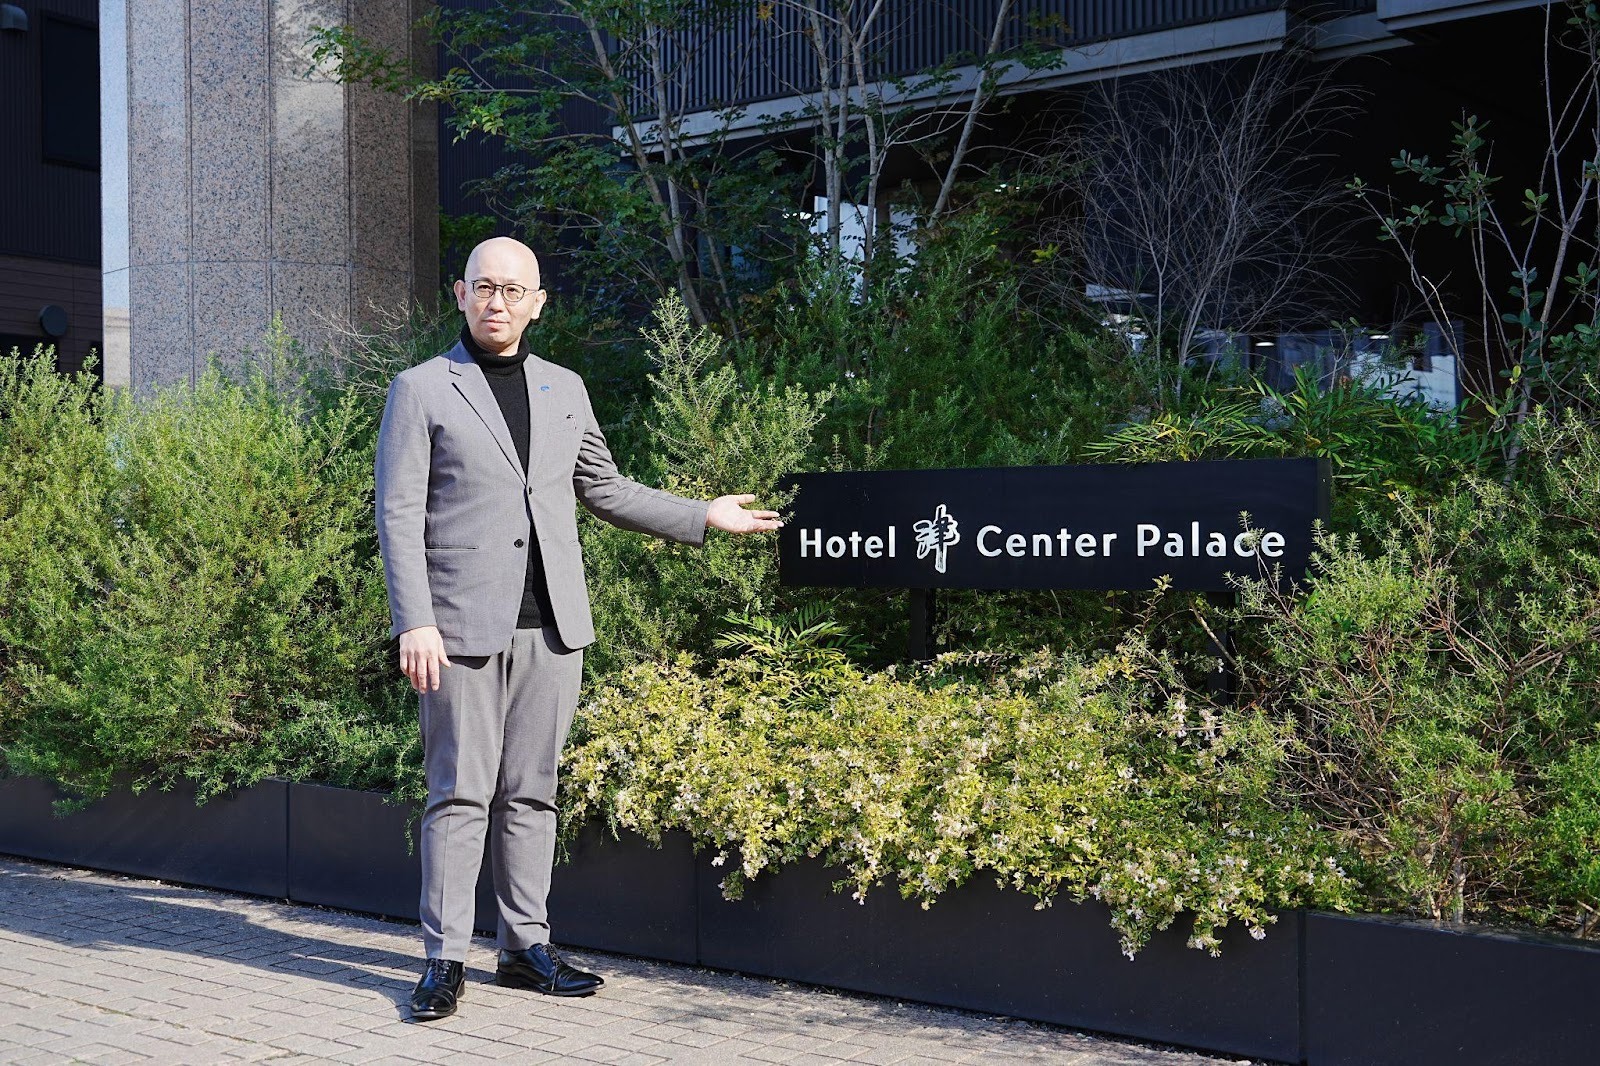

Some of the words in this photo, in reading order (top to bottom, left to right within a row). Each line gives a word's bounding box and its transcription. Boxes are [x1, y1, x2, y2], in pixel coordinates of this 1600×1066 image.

[800, 526, 896, 559] Hotel
[976, 524, 1118, 558] Center
[1137, 521, 1286, 558] Palace
